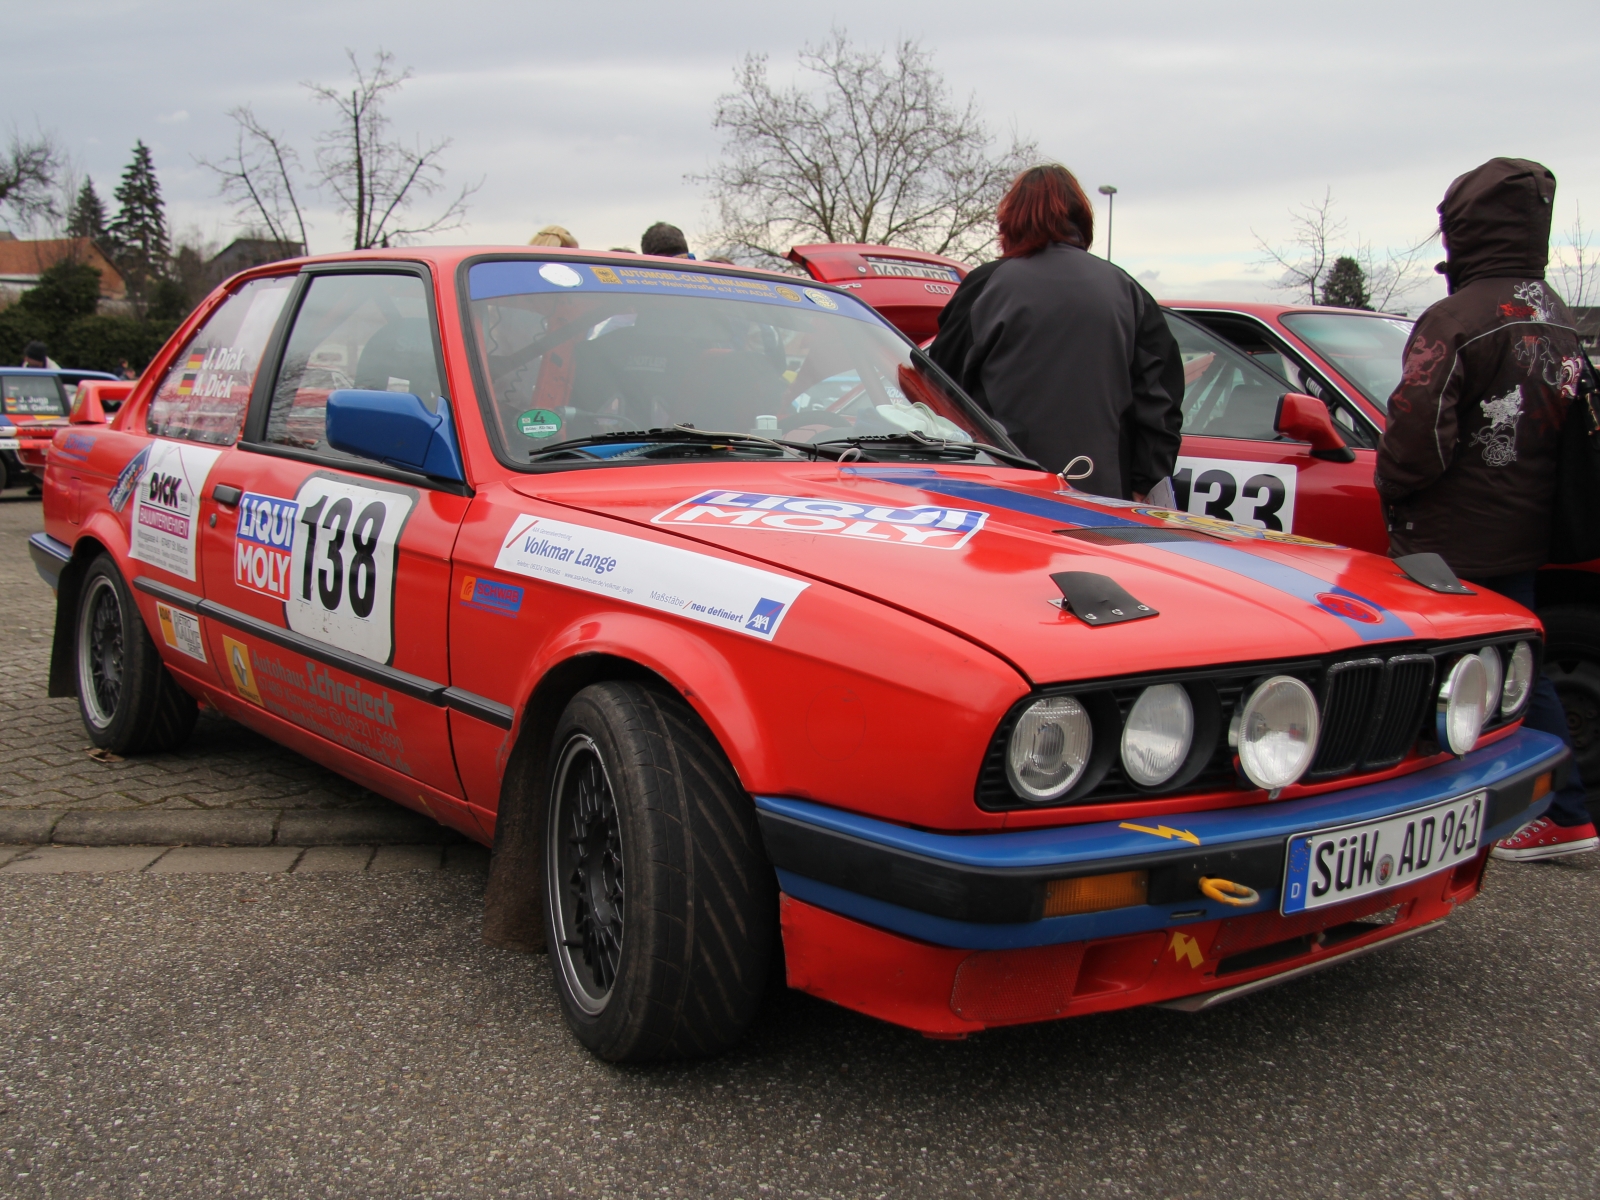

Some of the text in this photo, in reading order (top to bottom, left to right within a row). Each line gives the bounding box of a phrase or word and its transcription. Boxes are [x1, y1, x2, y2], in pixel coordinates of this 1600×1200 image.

[202, 348, 244, 371] J. Dick
[205, 374, 235, 398] Dick
[533, 411, 546, 424] 4
[240, 497, 296, 547] LIQUI
[672, 504, 959, 545] MOLY
[705, 491, 968, 530] LIQUI
[237, 541, 291, 595] MOLY
[300, 494, 387, 619] 138
[523, 535, 618, 575] Volkmar Lange
[477, 582, 519, 604] SCHWAB
[649, 590, 744, 623] Maßstäbe neu definiert
[745, 613, 770, 631] AXA
[252, 649, 398, 730] Autohaus Schreieck
[1310, 798, 1482, 898] SÜW AD 961
[1290, 882, 1301, 899] D
